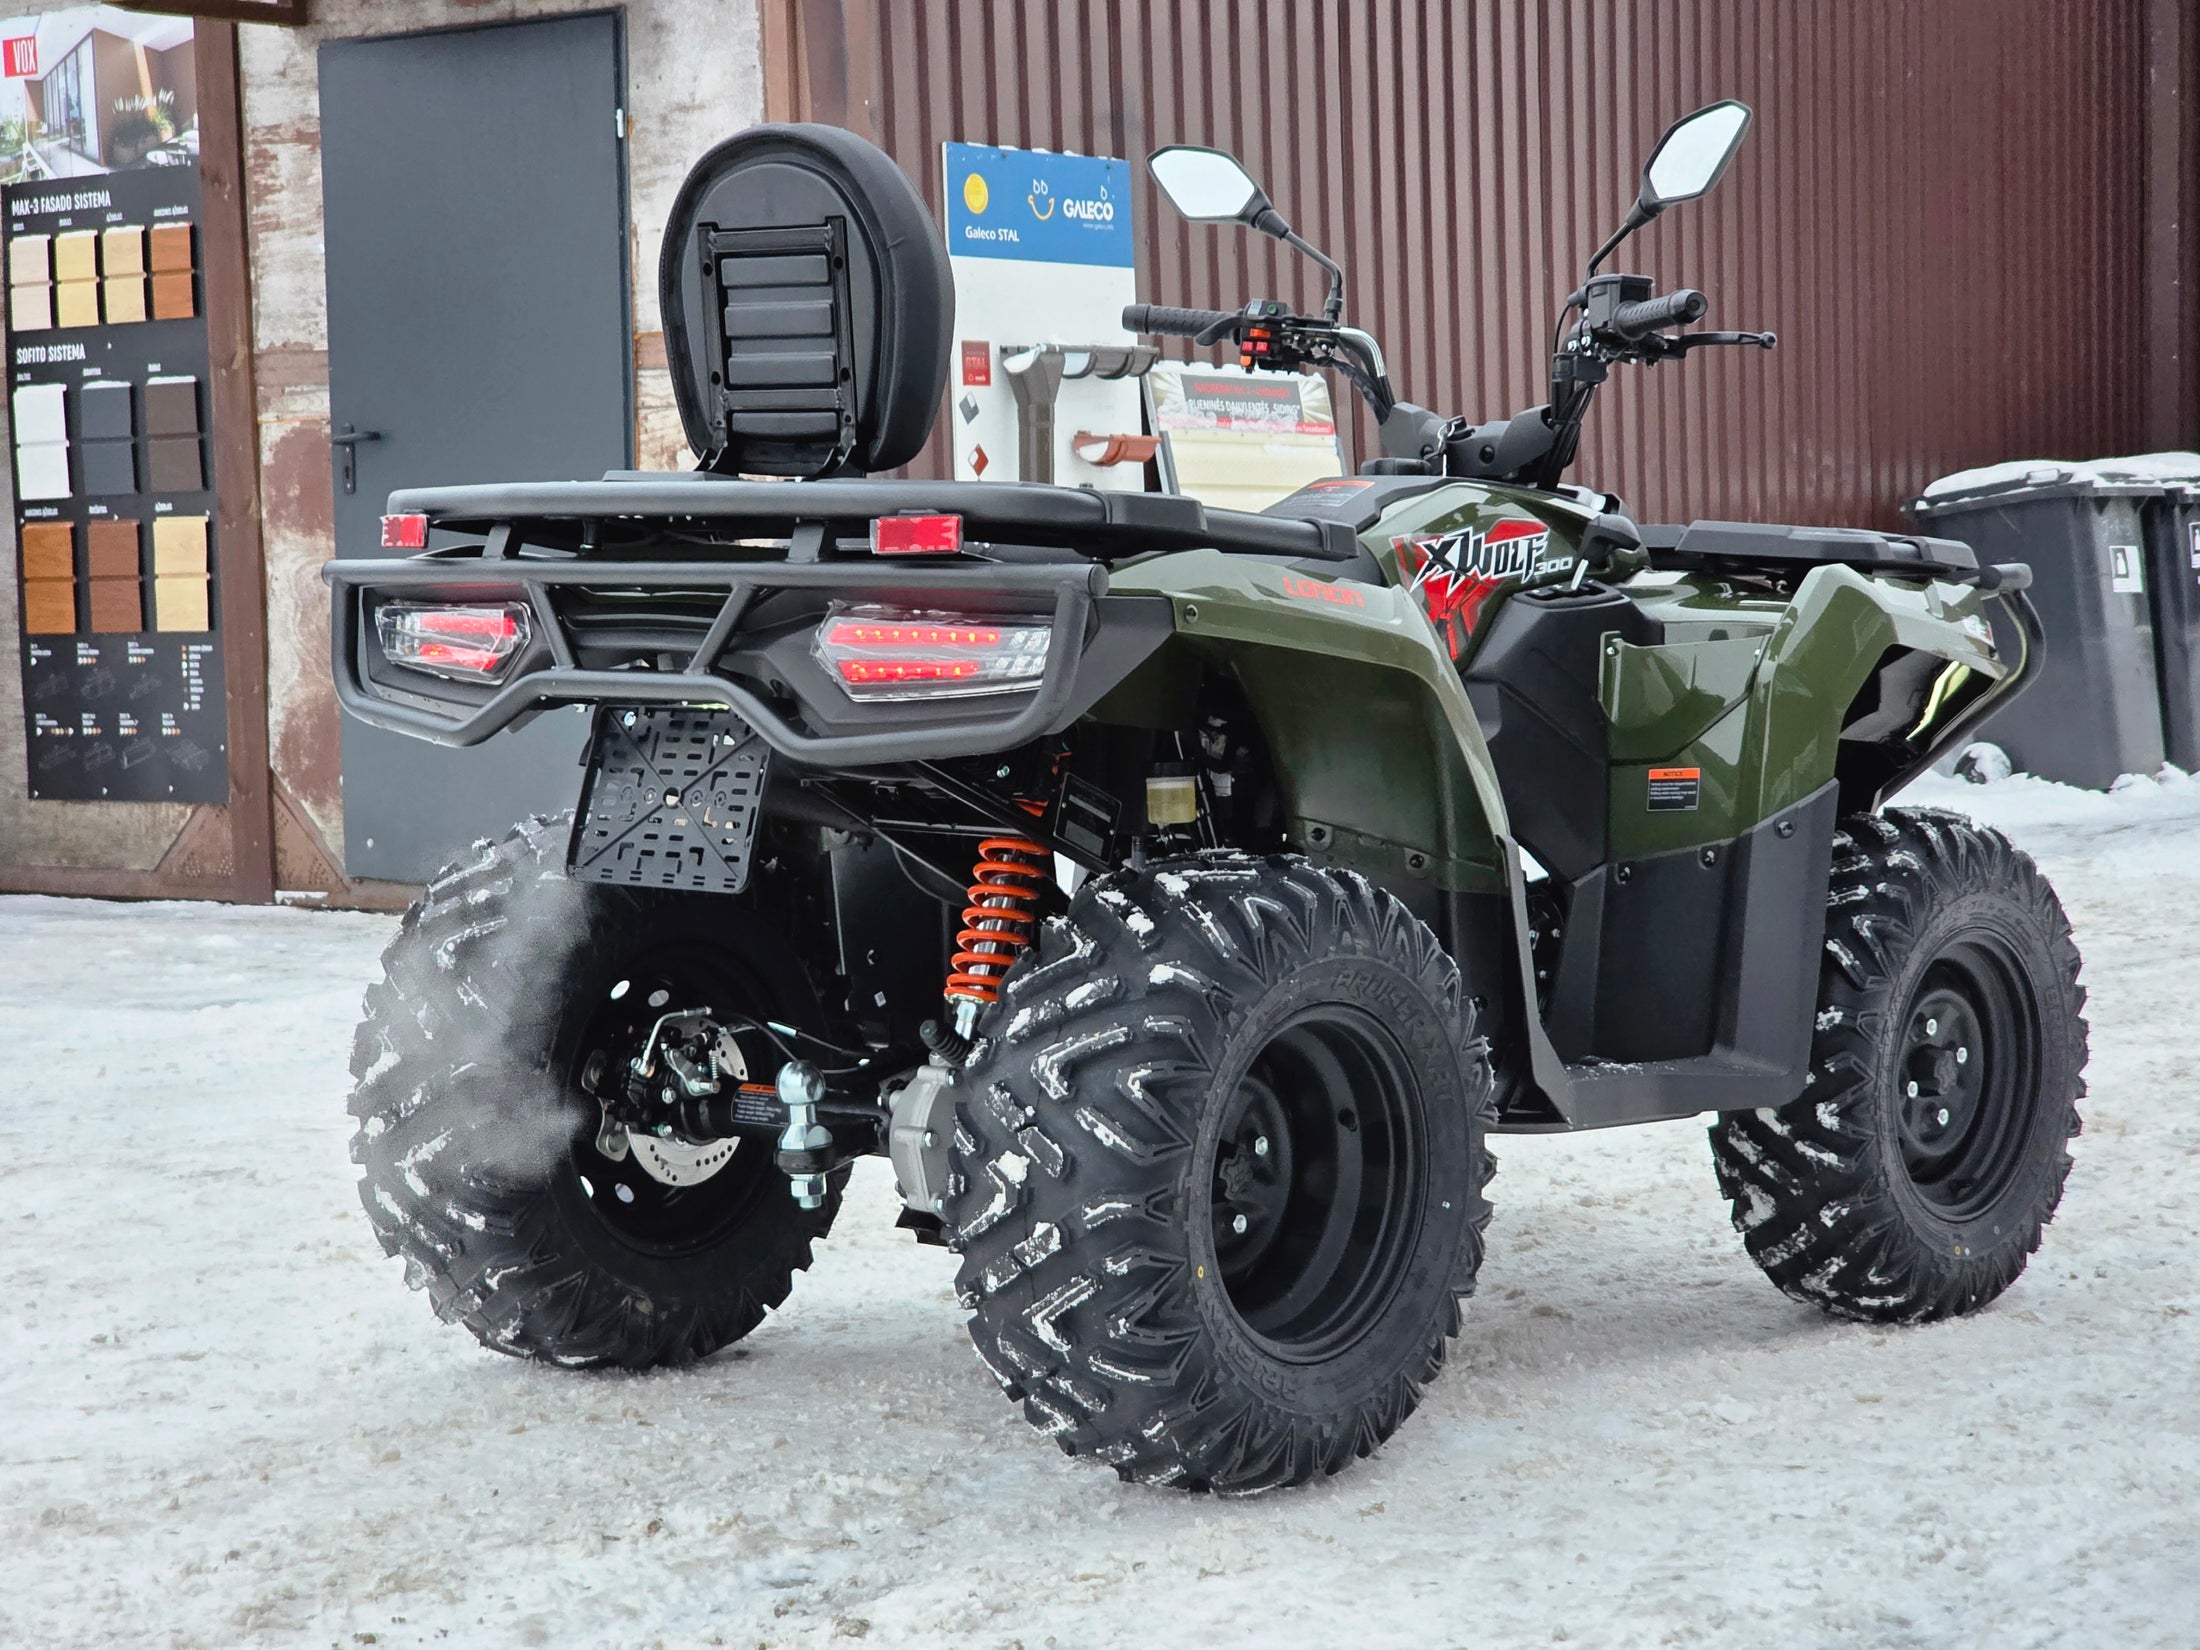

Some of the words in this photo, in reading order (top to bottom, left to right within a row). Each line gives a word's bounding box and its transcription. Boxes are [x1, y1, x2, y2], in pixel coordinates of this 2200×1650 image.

[13, 39, 36, 73] VOX
[12, 199, 39, 216] MAX-3
[41, 194, 72, 213] FASADO
[74, 190, 112, 209] SISTEMA
[1063, 198, 1114, 221] GALECO
[965, 225, 996, 240] Galeco
[998, 228, 1020, 242] STAL
[16, 346, 46, 365] SOFITO
[48, 343, 86, 362] SISTEMA
[1534, 556, 1573, 574] 300
